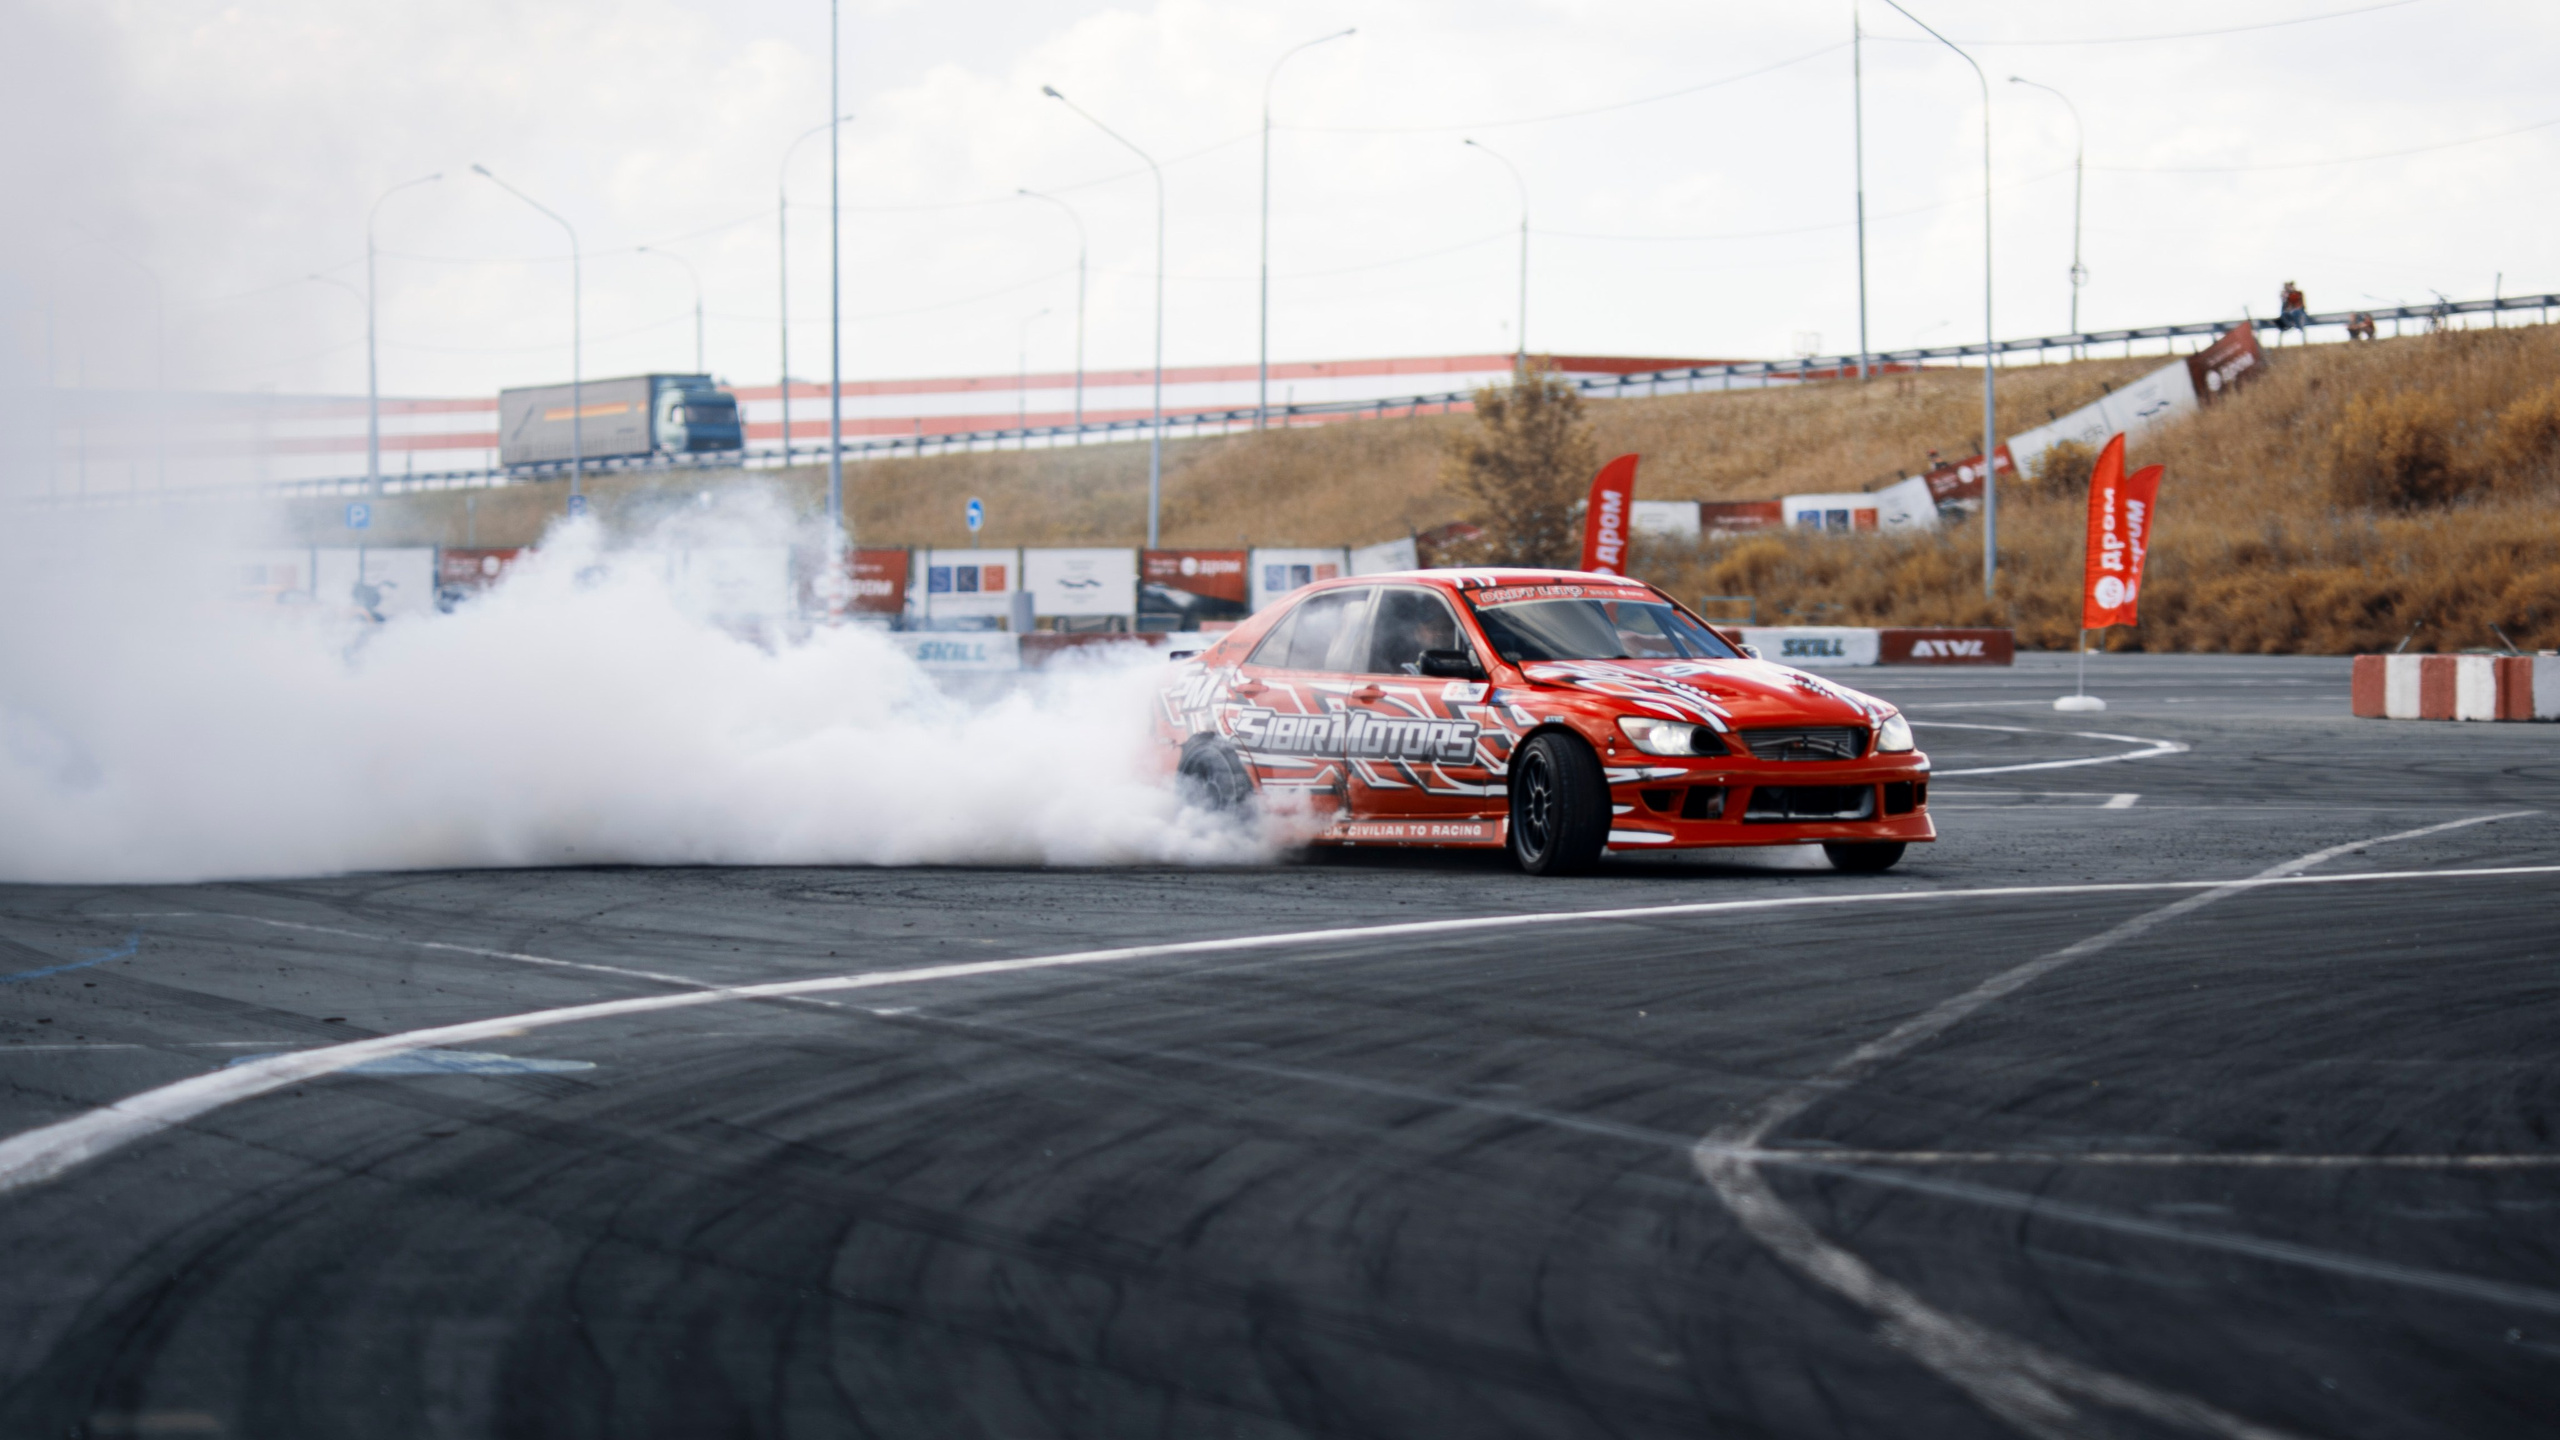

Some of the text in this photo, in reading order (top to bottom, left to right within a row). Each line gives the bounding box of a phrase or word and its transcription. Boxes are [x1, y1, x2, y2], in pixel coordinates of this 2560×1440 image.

[1479, 586, 1536, 603] DRIFT
[1536, 585, 1584, 598] LETO
[917, 641, 987, 661] SKILL
[1781, 638, 1846, 658] SKILL
[1347, 825, 1404, 837] CIVILIAN
[1409, 825, 1427, 837] TO
[1432, 825, 1482, 837] RACING
